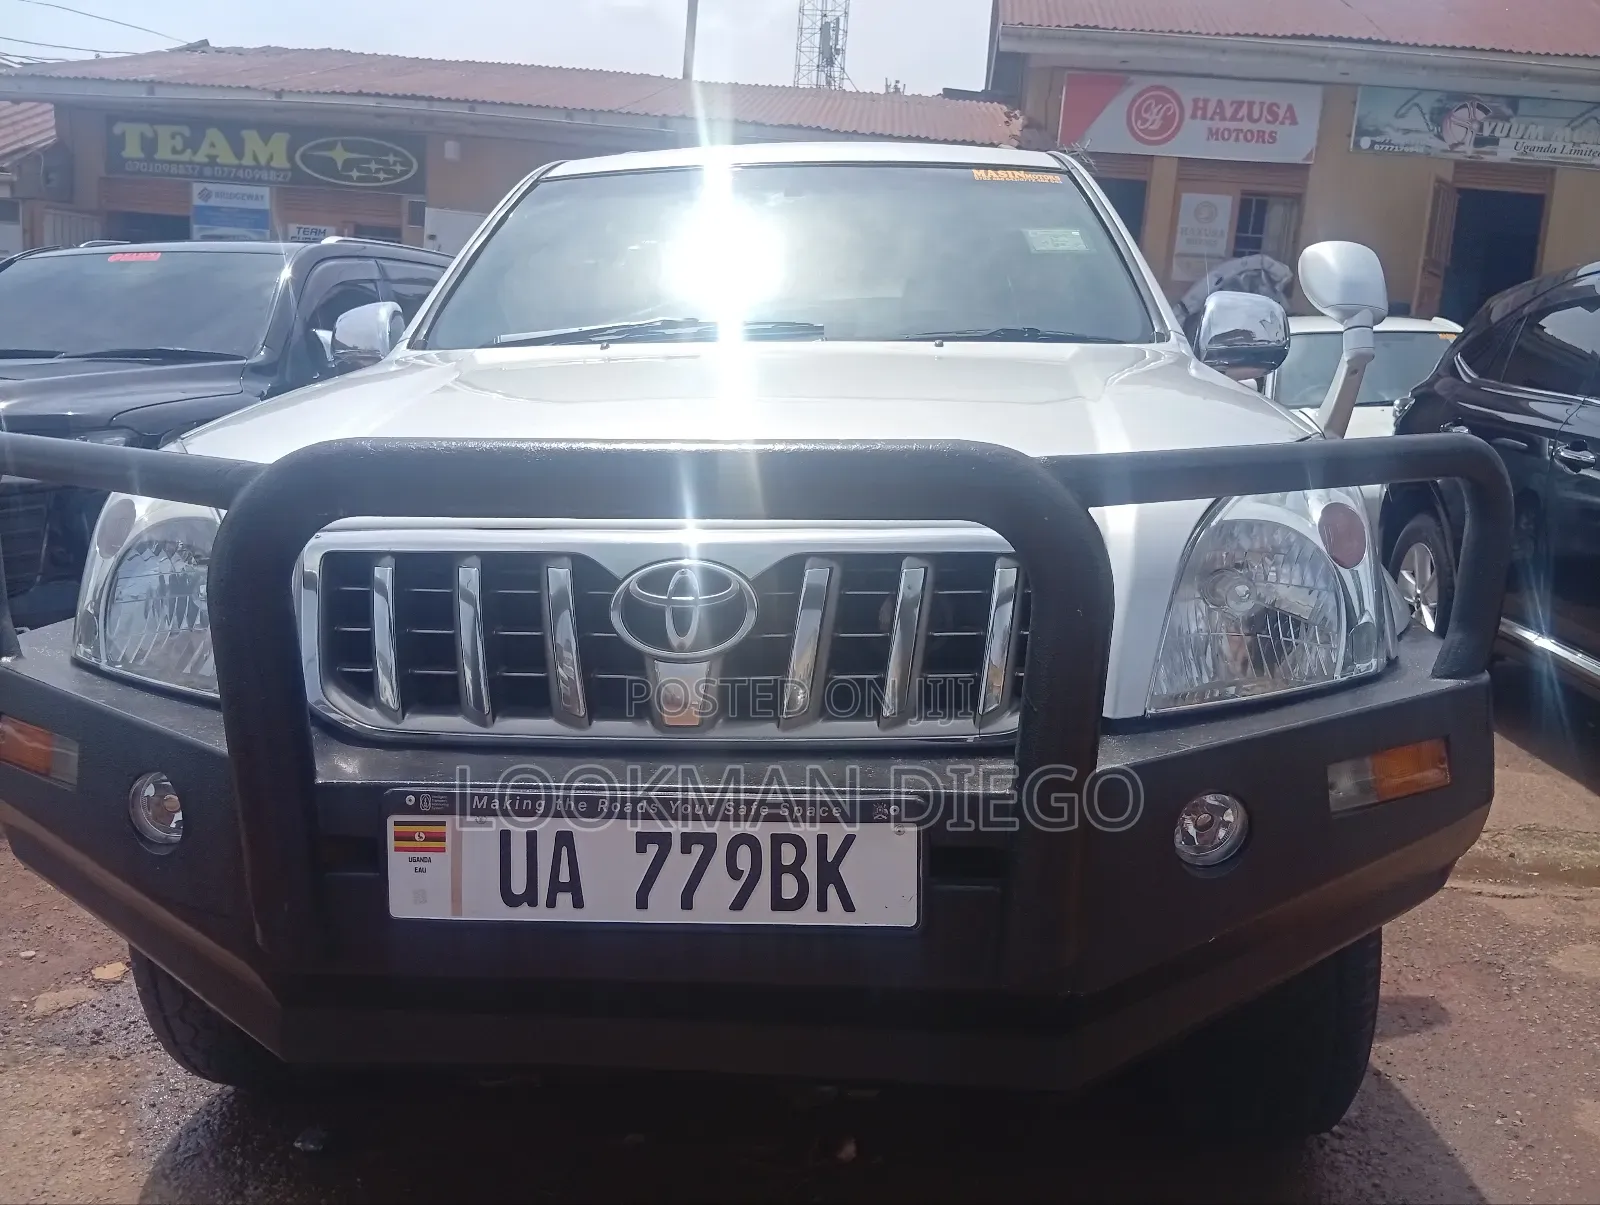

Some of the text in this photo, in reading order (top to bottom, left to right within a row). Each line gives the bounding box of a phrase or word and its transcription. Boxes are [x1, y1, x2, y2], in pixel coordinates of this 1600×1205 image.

[1190, 98, 1298, 126] HAZUSA
[113, 121, 291, 169] TEAM
[1206, 127, 1277, 144] MOTORS
[1513, 141, 1557, 155] Uganda
[972, 169, 1025, 180] MASIN
[296, 226, 327, 237] TEAM
[472, 796, 842, 820] Making the Roads Your Safe Space
[499, 829, 857, 912] UA 779BK
